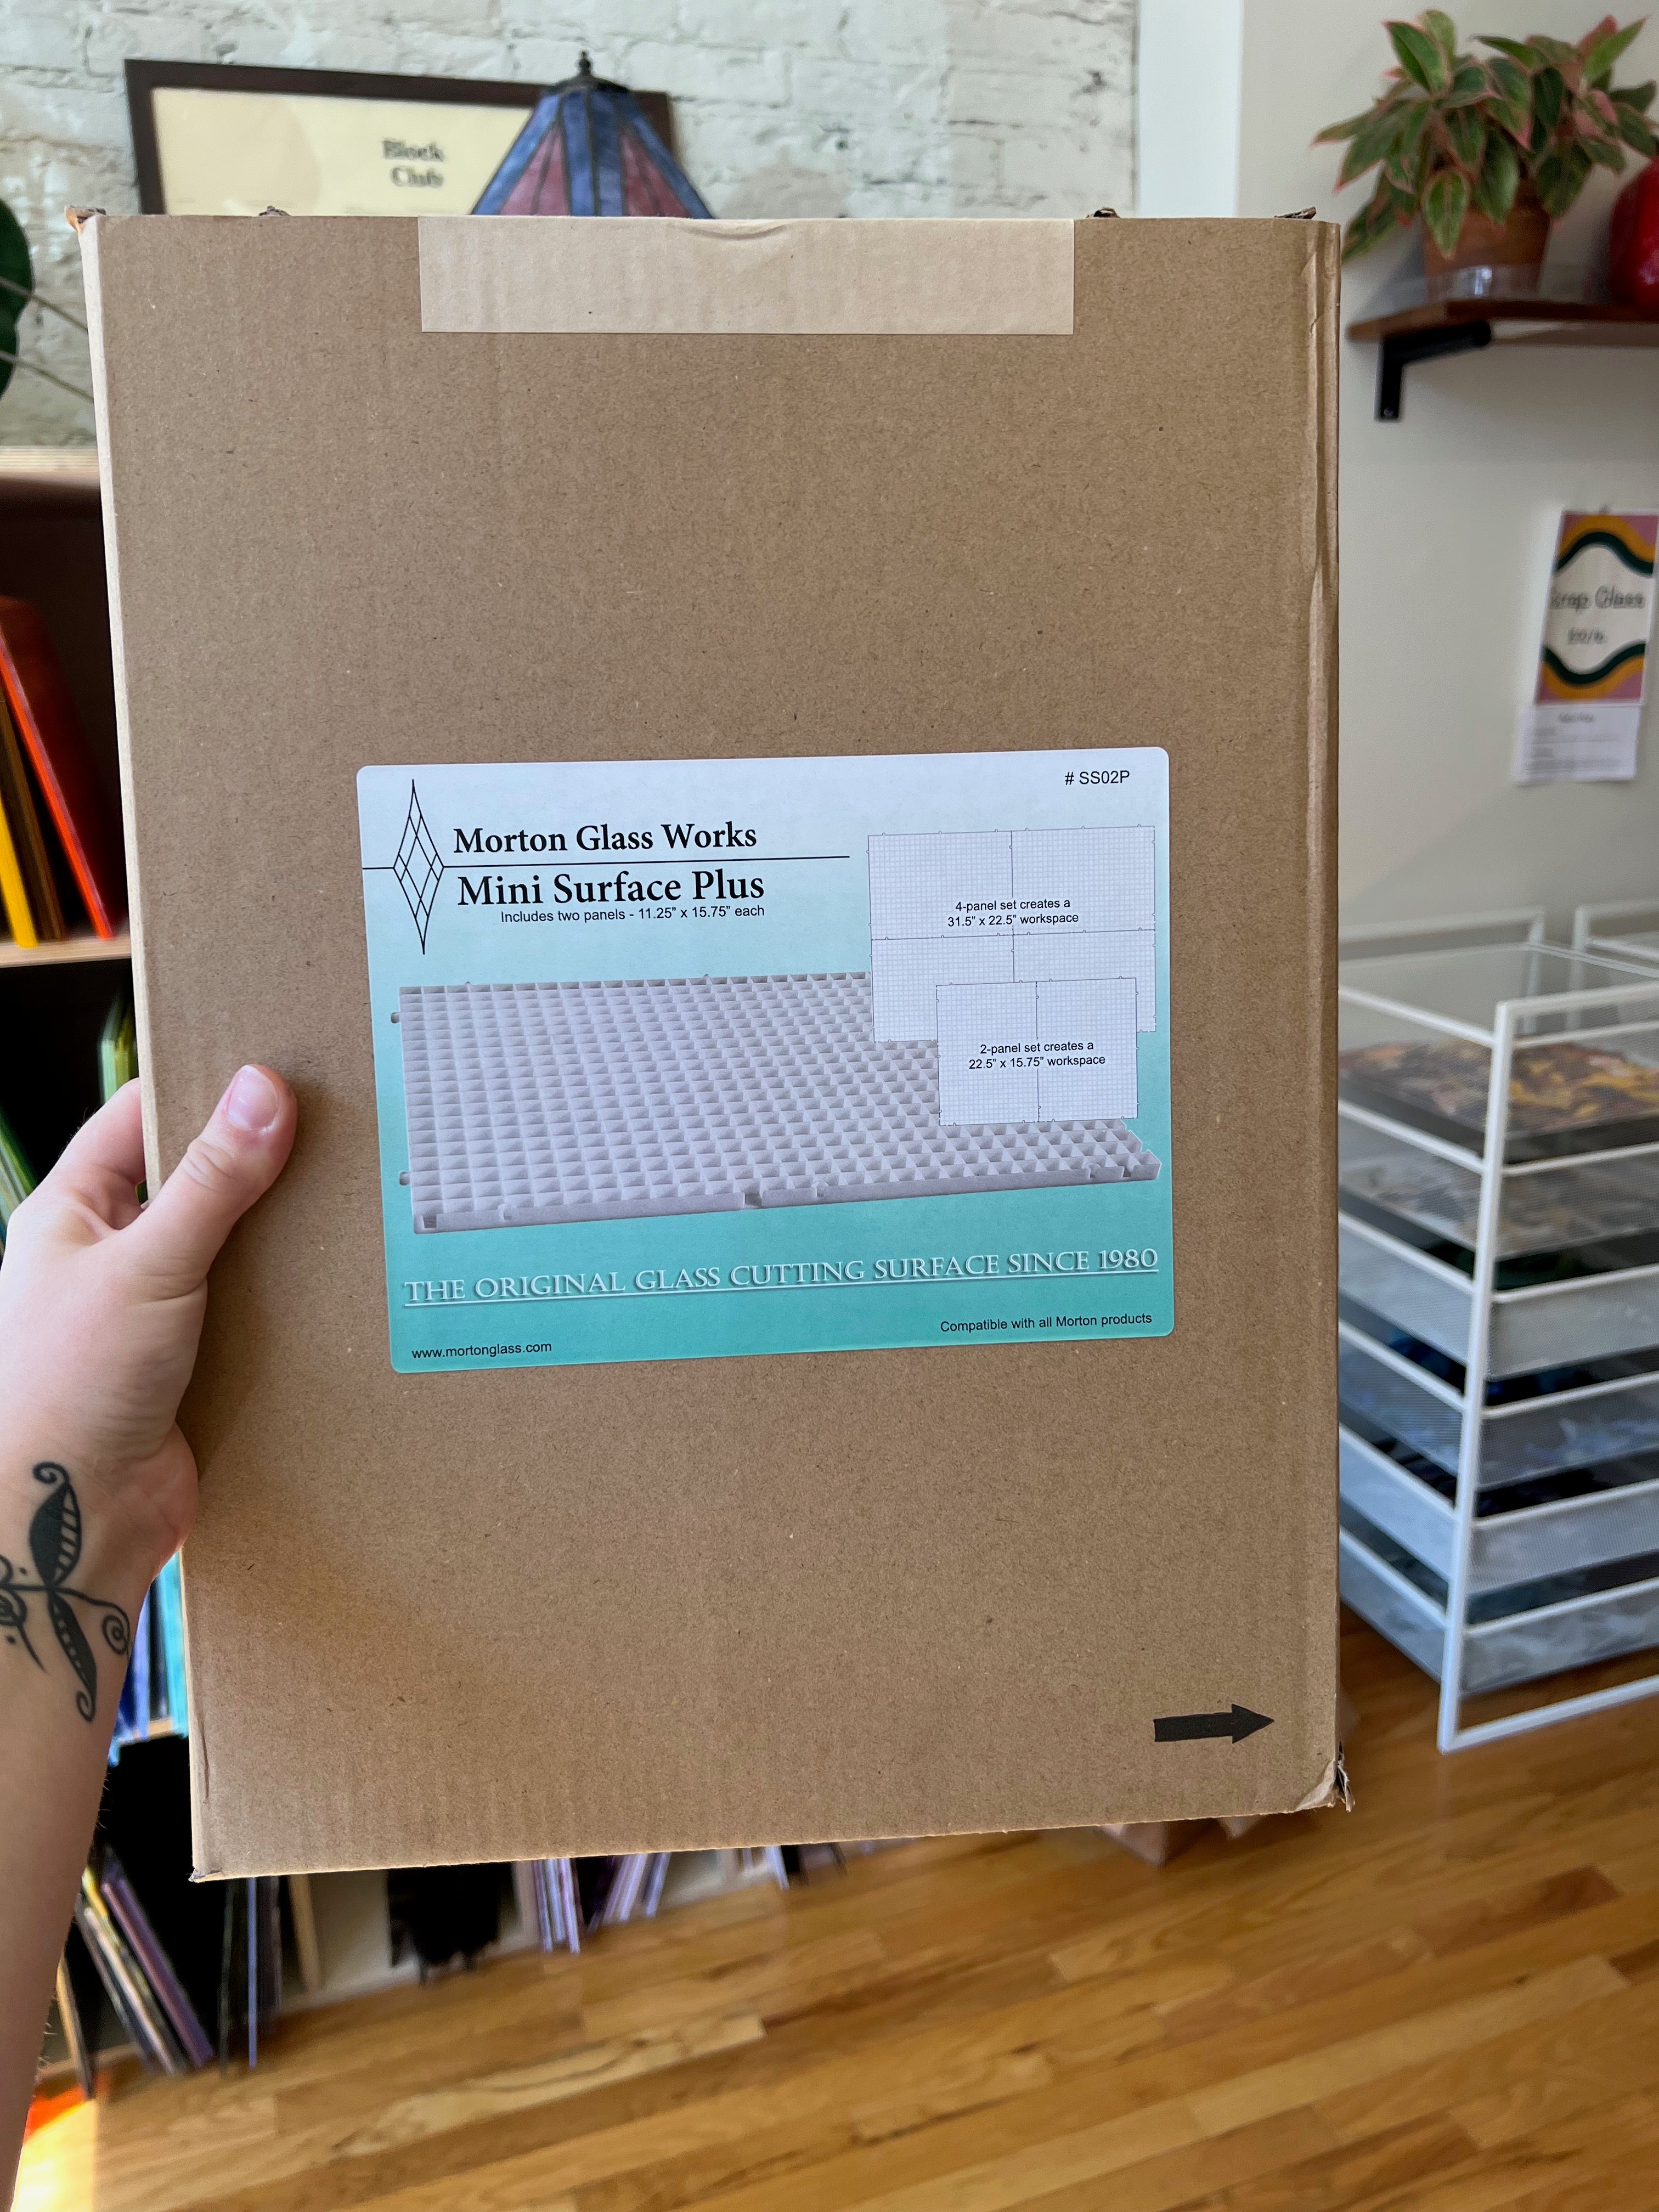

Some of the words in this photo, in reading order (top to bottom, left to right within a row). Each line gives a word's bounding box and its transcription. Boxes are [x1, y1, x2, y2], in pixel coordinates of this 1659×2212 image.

[1064, 771, 1075, 786] #
[1079, 770, 1130, 785] SS02P
[453, 828, 568, 853] Morton
[576, 823, 653, 851] Glass
[661, 820, 757, 849] Works
[458, 874, 544, 905] Mini
[554, 871, 681, 904] Surface
[691, 868, 764, 900] Plus
[501, 910, 554, 923] Includes
[558, 911, 580, 921] two
[584, 909, 625, 923] panels
[680, 909, 688, 918] x
[735, 905, 765, 917] each
[955, 900, 996, 913] 4-panel
[1000, 900, 1017, 910] set
[1020, 899, 1059, 910] creates
[1063, 900, 1071, 908] a
[979, 918, 985, 926] x
[1020, 913, 1079, 926] workspace
[980, 1042, 1020, 1056] 2-panel
[1024, 1042, 1041, 1052] set
[1043, 1041, 1084, 1052] creates
[1000, 1060, 1006, 1068] x
[1047, 1056, 1105, 1067] workspace
[404, 1279, 466, 1303] THE
[475, 1271, 626, 1298] ORIGINAL
[634, 1266, 721, 1290] GLASS
[730, 1260, 865, 1284] CUTTING
[874, 1255, 1000, 1280] SURFACE
[1007, 1250, 1089, 1273] SINCE
[1098, 1247, 1158, 1269] 1980
[940, 1319, 1008, 1333] Compatible
[1011, 1317, 1035, 1329] with
[1039, 1316, 1052, 1328] all
[1056, 1316, 1097, 1327] Morton
[1101, 1313, 1152, 1328] products
[411, 1343, 552, 1358] www.mortonglass.com
